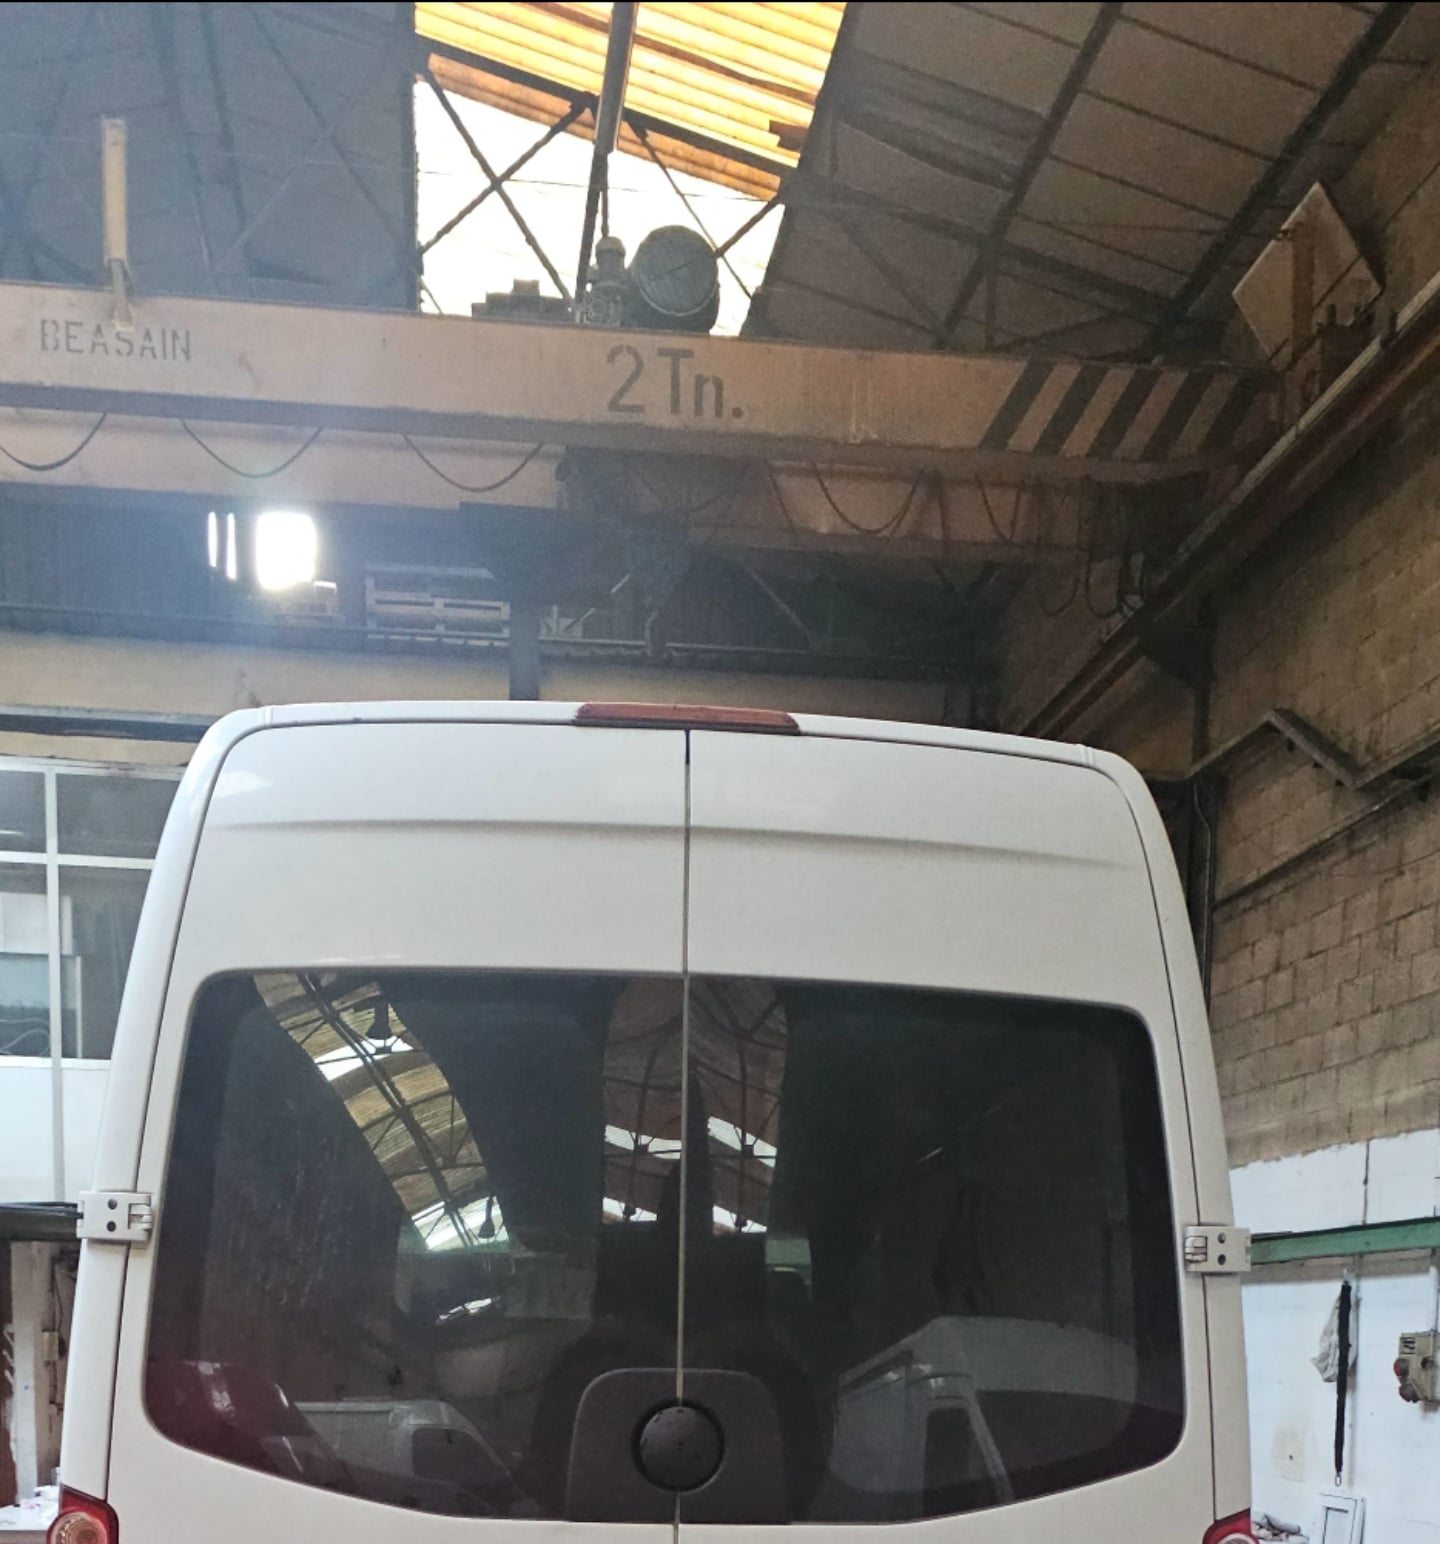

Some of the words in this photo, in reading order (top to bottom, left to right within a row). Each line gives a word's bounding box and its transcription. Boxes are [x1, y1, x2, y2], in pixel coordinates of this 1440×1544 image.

[39, 319, 192, 362] BEASAIN
[607, 344, 645, 413] 2
[657, 346, 744, 419] Tn.
